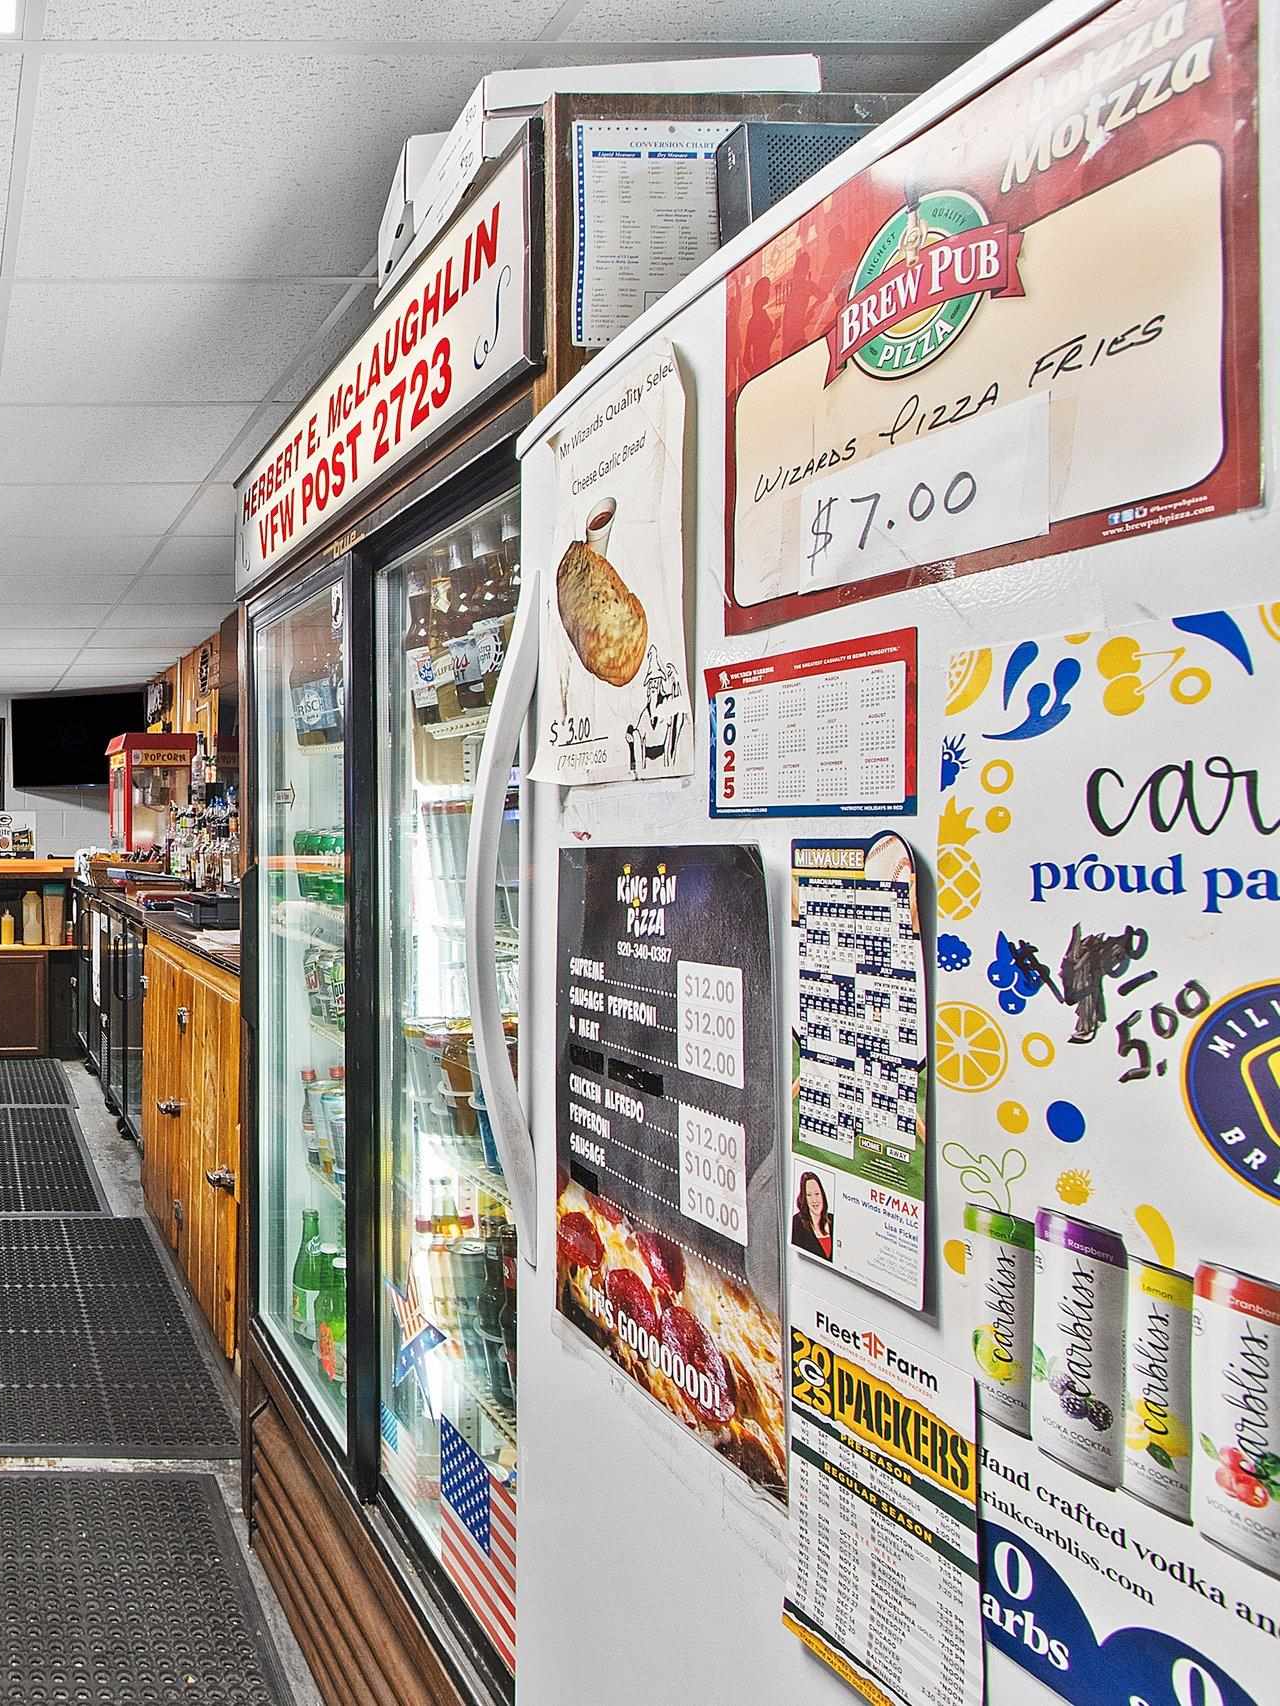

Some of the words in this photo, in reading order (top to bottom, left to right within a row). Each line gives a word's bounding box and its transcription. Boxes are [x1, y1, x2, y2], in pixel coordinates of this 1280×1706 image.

[1001, 38, 1215, 194] Motzza
[866, 231, 897, 276] HIGHEST
[931, 206, 969, 228] QUALITY
[840, 263, 925, 354] BREW
[927, 239, 1001, 296] PUB
[242, 428, 303, 527] HERBERT
[306, 414, 321, 453] E.
[326, 202, 502, 433] McLAUGHLIN
[876, 318, 955, 369] PIZZA
[559, 443, 571, 461] Mr
[572, 414, 603, 450] Wizards
[605, 384, 644, 421] Quality
[753, 439, 856, 502] WIZARDS
[879, 381, 999, 446] PIZZA
[1028, 314, 1166, 389] FRIES
[258, 489, 296, 562] VFW
[301, 422, 363, 529] POST
[371, 336, 453, 466] 2723
[571, 468, 598, 496] Cheese
[598, 451, 622, 478] Garlic
[622, 430, 647, 462] Bread
[806, 470, 977, 577] $7.00
[1101, 505, 1216, 537] www.brewpubpizza.com
[143, 752, 186, 762] POPCORN
[794, 848, 865, 869] MILWAUKEE
[1030, 852, 1187, 903] proud
[617, 939, 672, 963] 920-340-0387
[569, 955, 605, 983] SUPREME
[683, 974, 736, 1005] $12.00
[569, 984, 605, 1013] SAUSAGE
[607, 993, 658, 1028] PEPPERONI
[683, 1010, 736, 1041] $12.00
[578, 1018, 601, 1042] MEAT
[683, 1047, 736, 1078] $12.00
[569, 1071, 602, 1107] CHICKEN
[604, 1087, 645, 1123] ALFREDO
[685, 1121, 738, 1160] $12.00
[569, 1101, 611, 1139] PEPPERONI
[684, 1153, 737, 1192] $10.00
[888, 1148, 907, 1161] AWAY
[569, 1131, 607, 1170] SAUSAGE
[686, 1187, 739, 1232] $10.00
[870, 1188, 920, 1219] RE/MAX
[842, 1192, 861, 1205] North
[861, 1200, 882, 1213] Winds
[905, 1218, 919, 1229] LLC
[884, 1221, 898, 1233] Lisa
[1067, 1238, 1115, 1262] Raspberry
[1142, 1283, 1173, 1302] Lemon
[589, 1286, 615, 1329] IT'S
[617, 1310, 722, 1418] GOOOOOOD!
[815, 1310, 861, 1350] Fleet
[886, 1347, 938, 1393] Farm
[837, 1367, 970, 1491] PACKERS
[1041, 1415, 1068, 1434] VODKA
[1069, 1430, 1113, 1457] COCKTAIL
[840, 1432, 912, 1486] PRESEASON
[824, 1462, 877, 1505] REGULAR
[880, 1501, 934, 1545] SEASON
[1207, 1496, 1242, 1523] VODKA
[870, 1516, 913, 1552] WASHINGTON
[980, 1447, 1030, 1492] Hand
[1036, 1485, 1128, 1550] crafted
[1130, 1538, 1228, 1610] vodka
[1235, 1599, 1280, 1641] an
[870, 1578, 903, 1608] CAROLINA
[993, 1541, 1033, 1601] 0
[870, 1587, 915, 1627] PHILADELPHIA
[868, 1622, 896, 1651] CHICAGO
